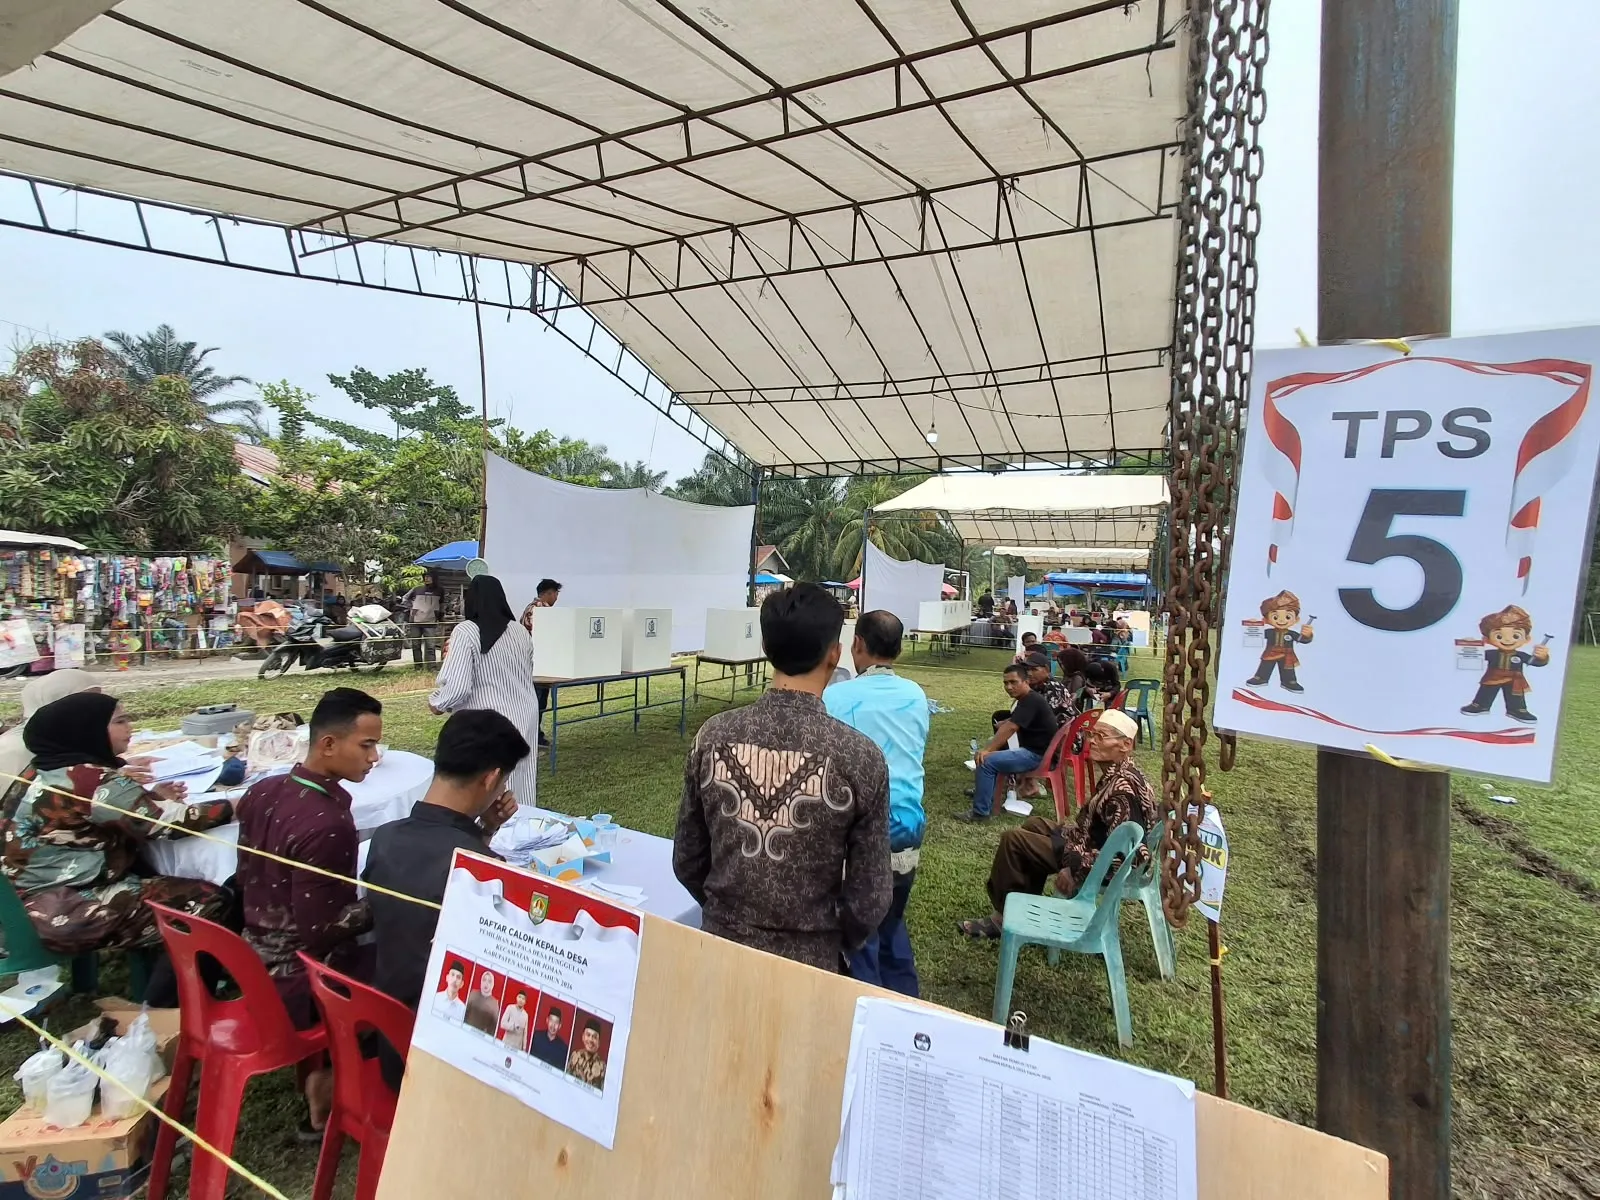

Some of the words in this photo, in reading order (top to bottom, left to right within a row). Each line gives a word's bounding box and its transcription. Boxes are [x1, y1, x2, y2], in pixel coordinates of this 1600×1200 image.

[1332, 407, 1492, 459] TPS
[1338, 488, 1467, 632] 5
[479, 916, 507, 934] DAFTAR
[508, 928, 534, 945] CALON
[535, 938, 565, 957] KEPALA
[567, 951, 588, 967] DESA
[510, 939, 532, 954] KEPALA
